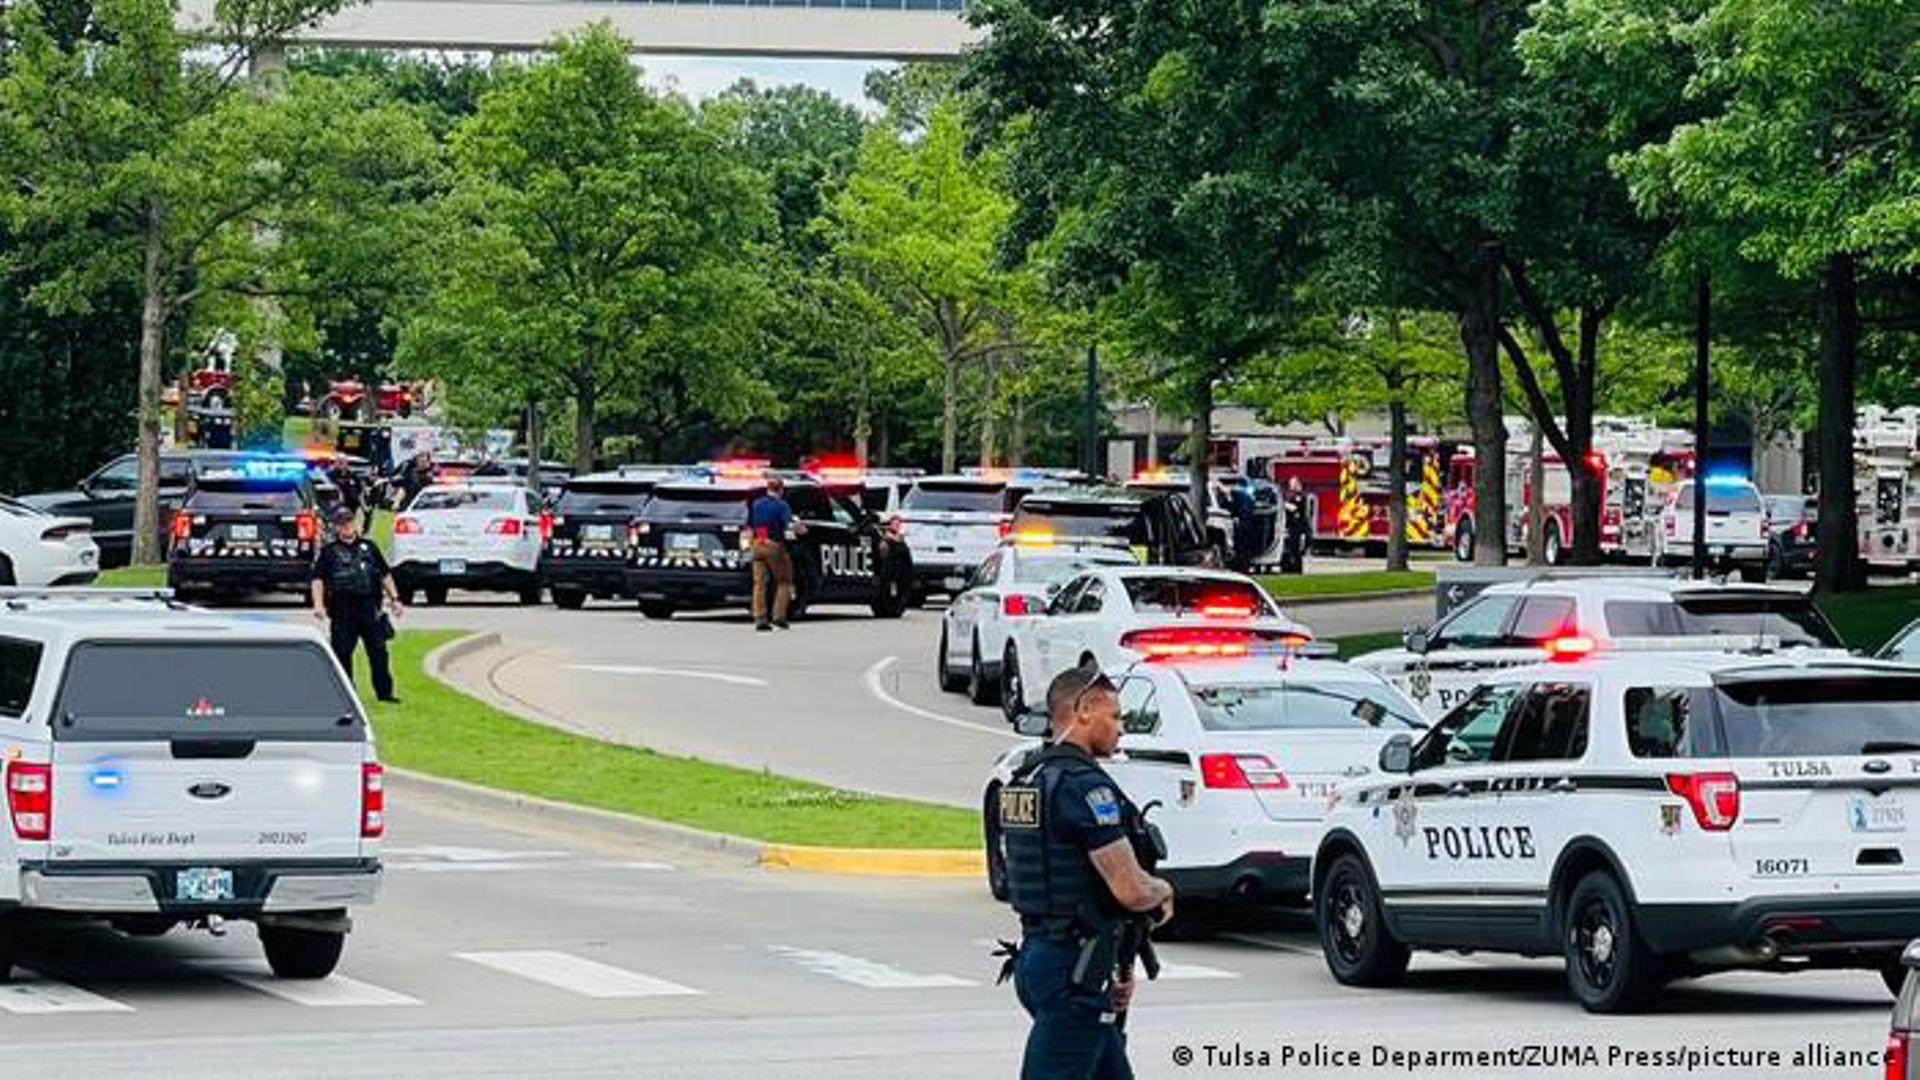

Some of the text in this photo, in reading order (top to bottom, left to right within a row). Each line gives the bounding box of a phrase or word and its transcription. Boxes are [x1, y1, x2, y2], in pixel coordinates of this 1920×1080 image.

[820, 544, 875, 577] POLICE
[1767, 760, 1833, 777] TULSA
[1001, 792, 1035, 823] POLICE
[1422, 825, 1536, 859] POLICE
[1755, 858, 1809, 875] 16071
